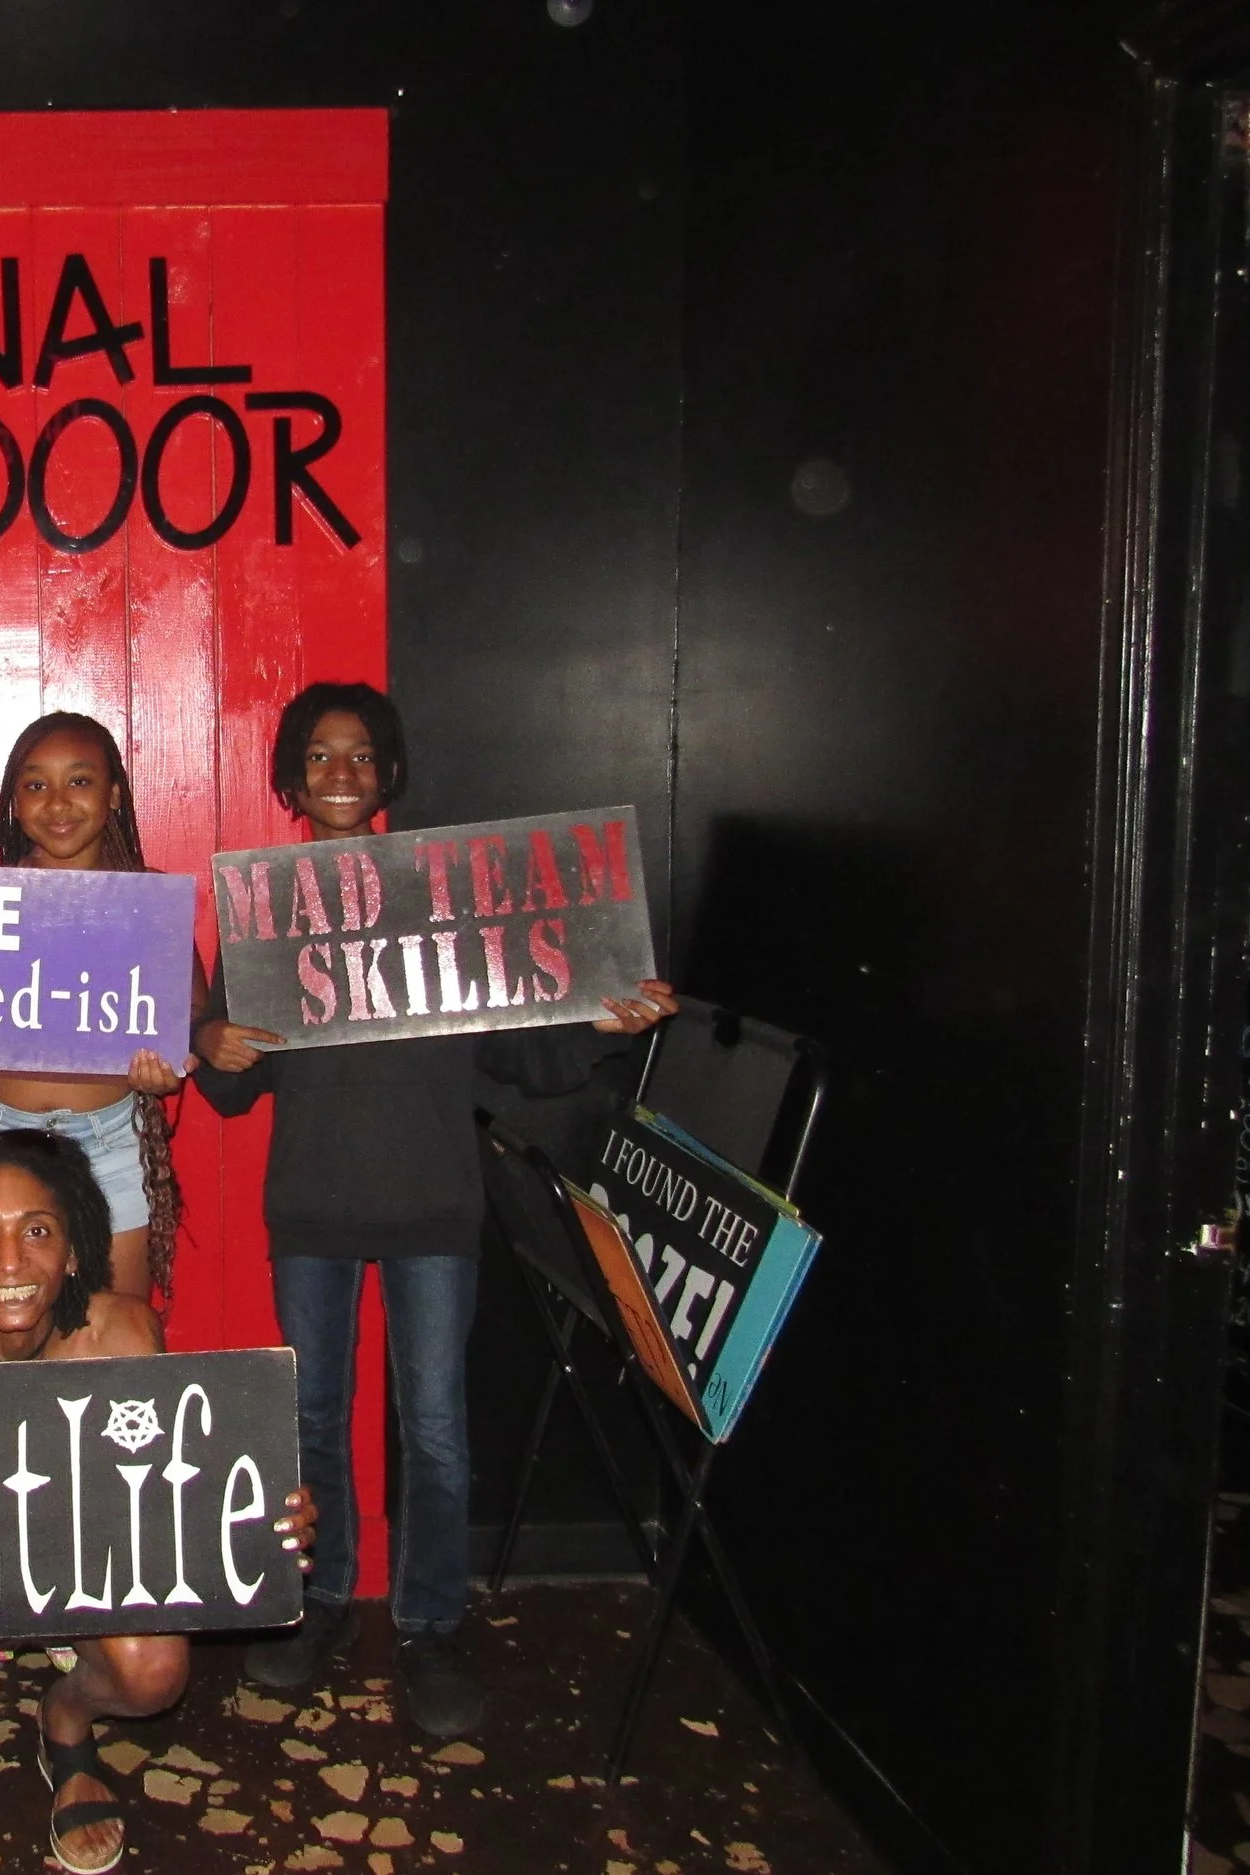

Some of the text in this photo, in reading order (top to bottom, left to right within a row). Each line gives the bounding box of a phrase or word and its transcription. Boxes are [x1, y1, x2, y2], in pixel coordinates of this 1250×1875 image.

[218, 821, 632, 943] MAD TEAM
[296, 919, 572, 1026] SKILLS
[601, 1129, 761, 1269] I FOUND THE
